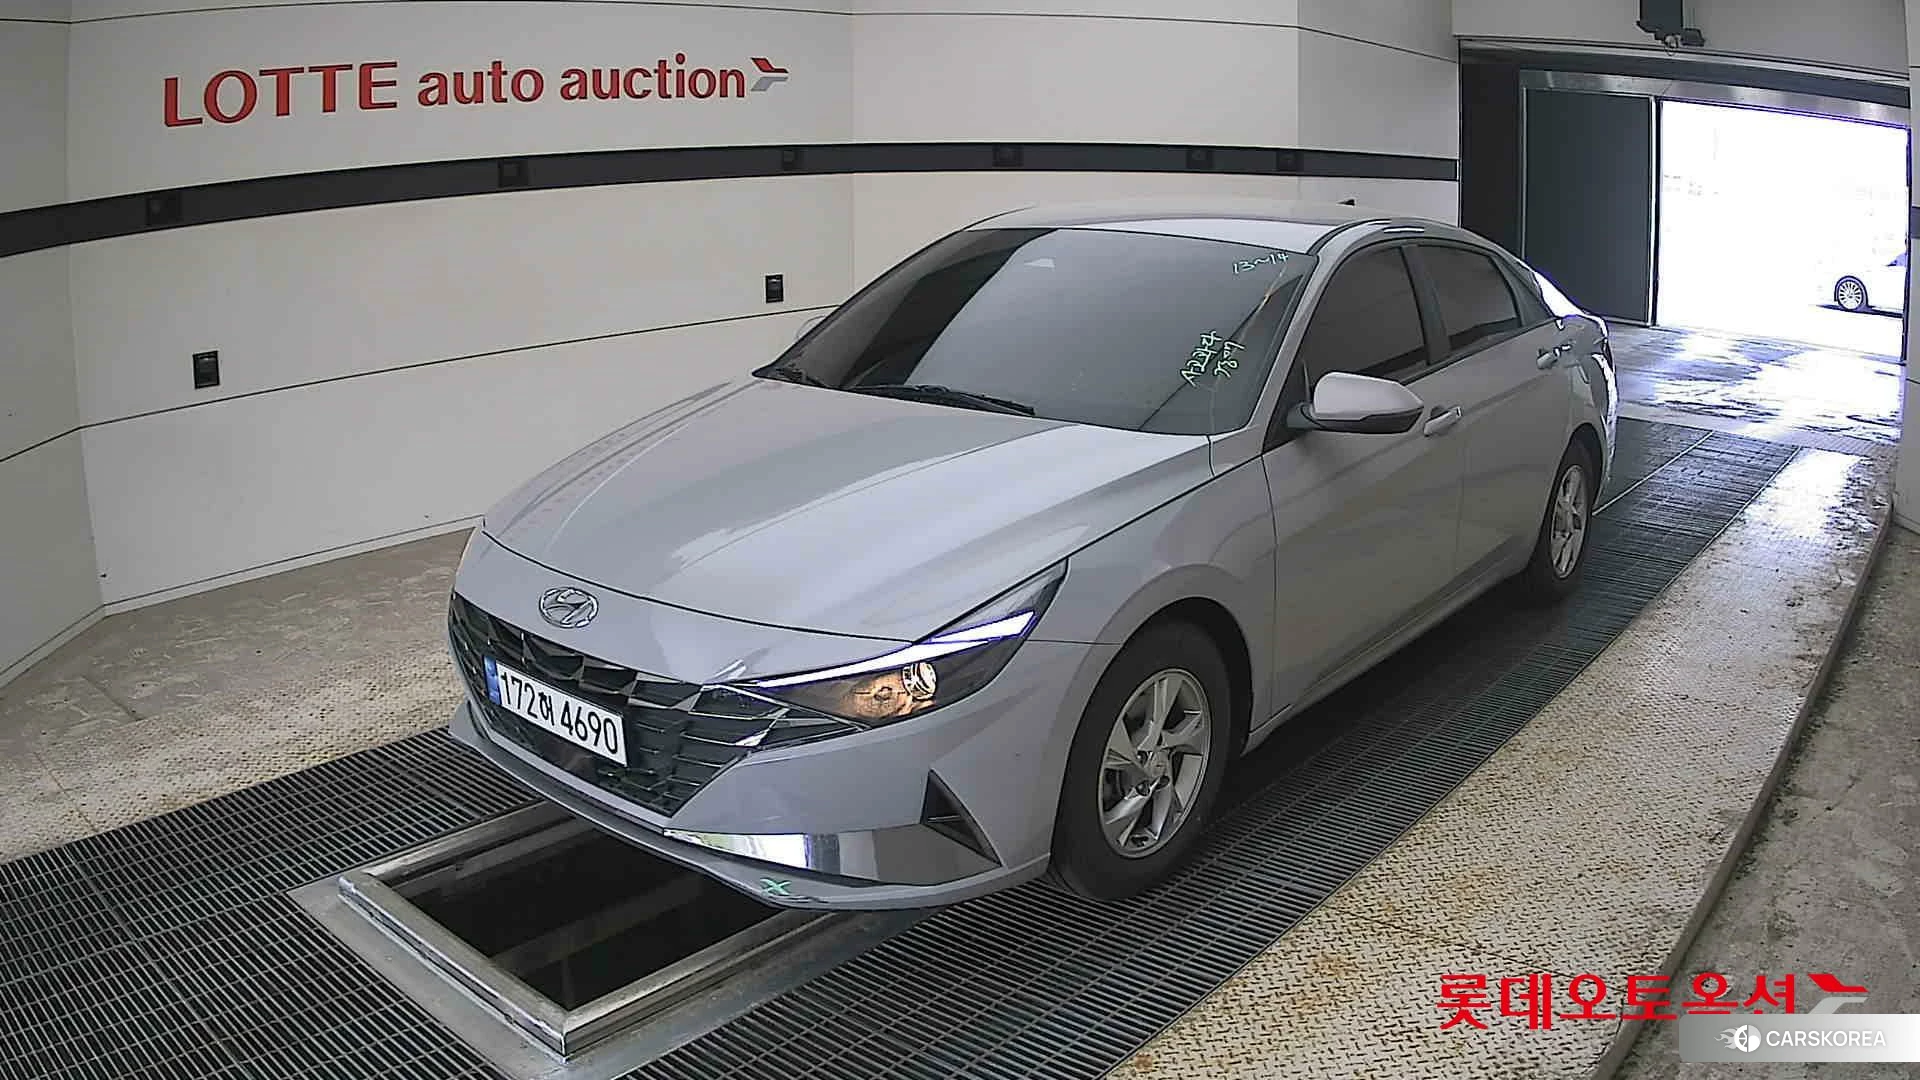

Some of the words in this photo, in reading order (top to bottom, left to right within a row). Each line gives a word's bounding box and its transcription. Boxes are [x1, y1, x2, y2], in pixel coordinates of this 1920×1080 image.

[164, 61, 399, 127] LOTTE
[417, 60, 545, 107] auto
[560, 53, 745, 101] auction
[559, 700, 618, 755] 4690
